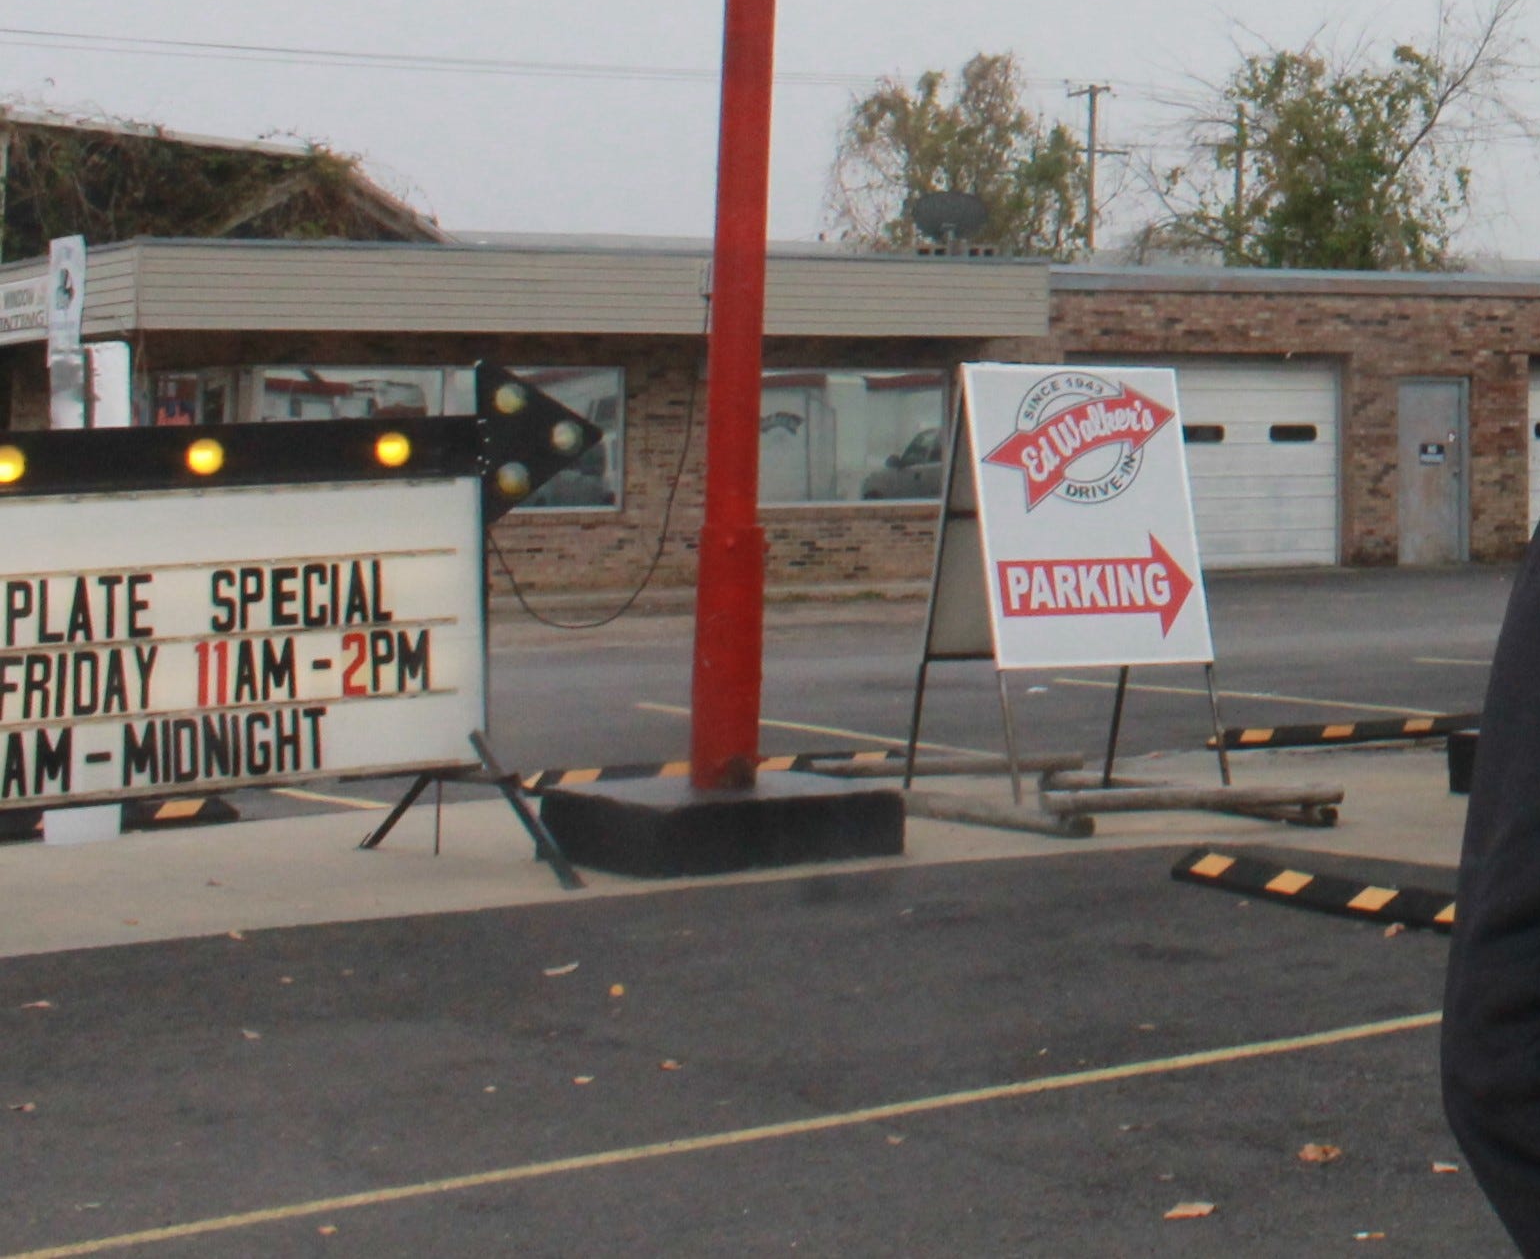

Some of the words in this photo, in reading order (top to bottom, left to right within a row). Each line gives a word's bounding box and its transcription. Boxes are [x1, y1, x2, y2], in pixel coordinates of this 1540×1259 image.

[1023, 380, 1060, 421] SINCE
[1065, 377, 1105, 395] 1943
[1021, 436, 1061, 483] Ed
[1048, 400, 1155, 457] Walker's
[1064, 453, 1137, 499] DRIVE-IN
[6, 574, 153, 646] PLATE
[210, 558, 393, 634] SPECIAL
[1006, 561, 1172, 611] PARKING
[0, 644, 158, 720] FRIDAY
